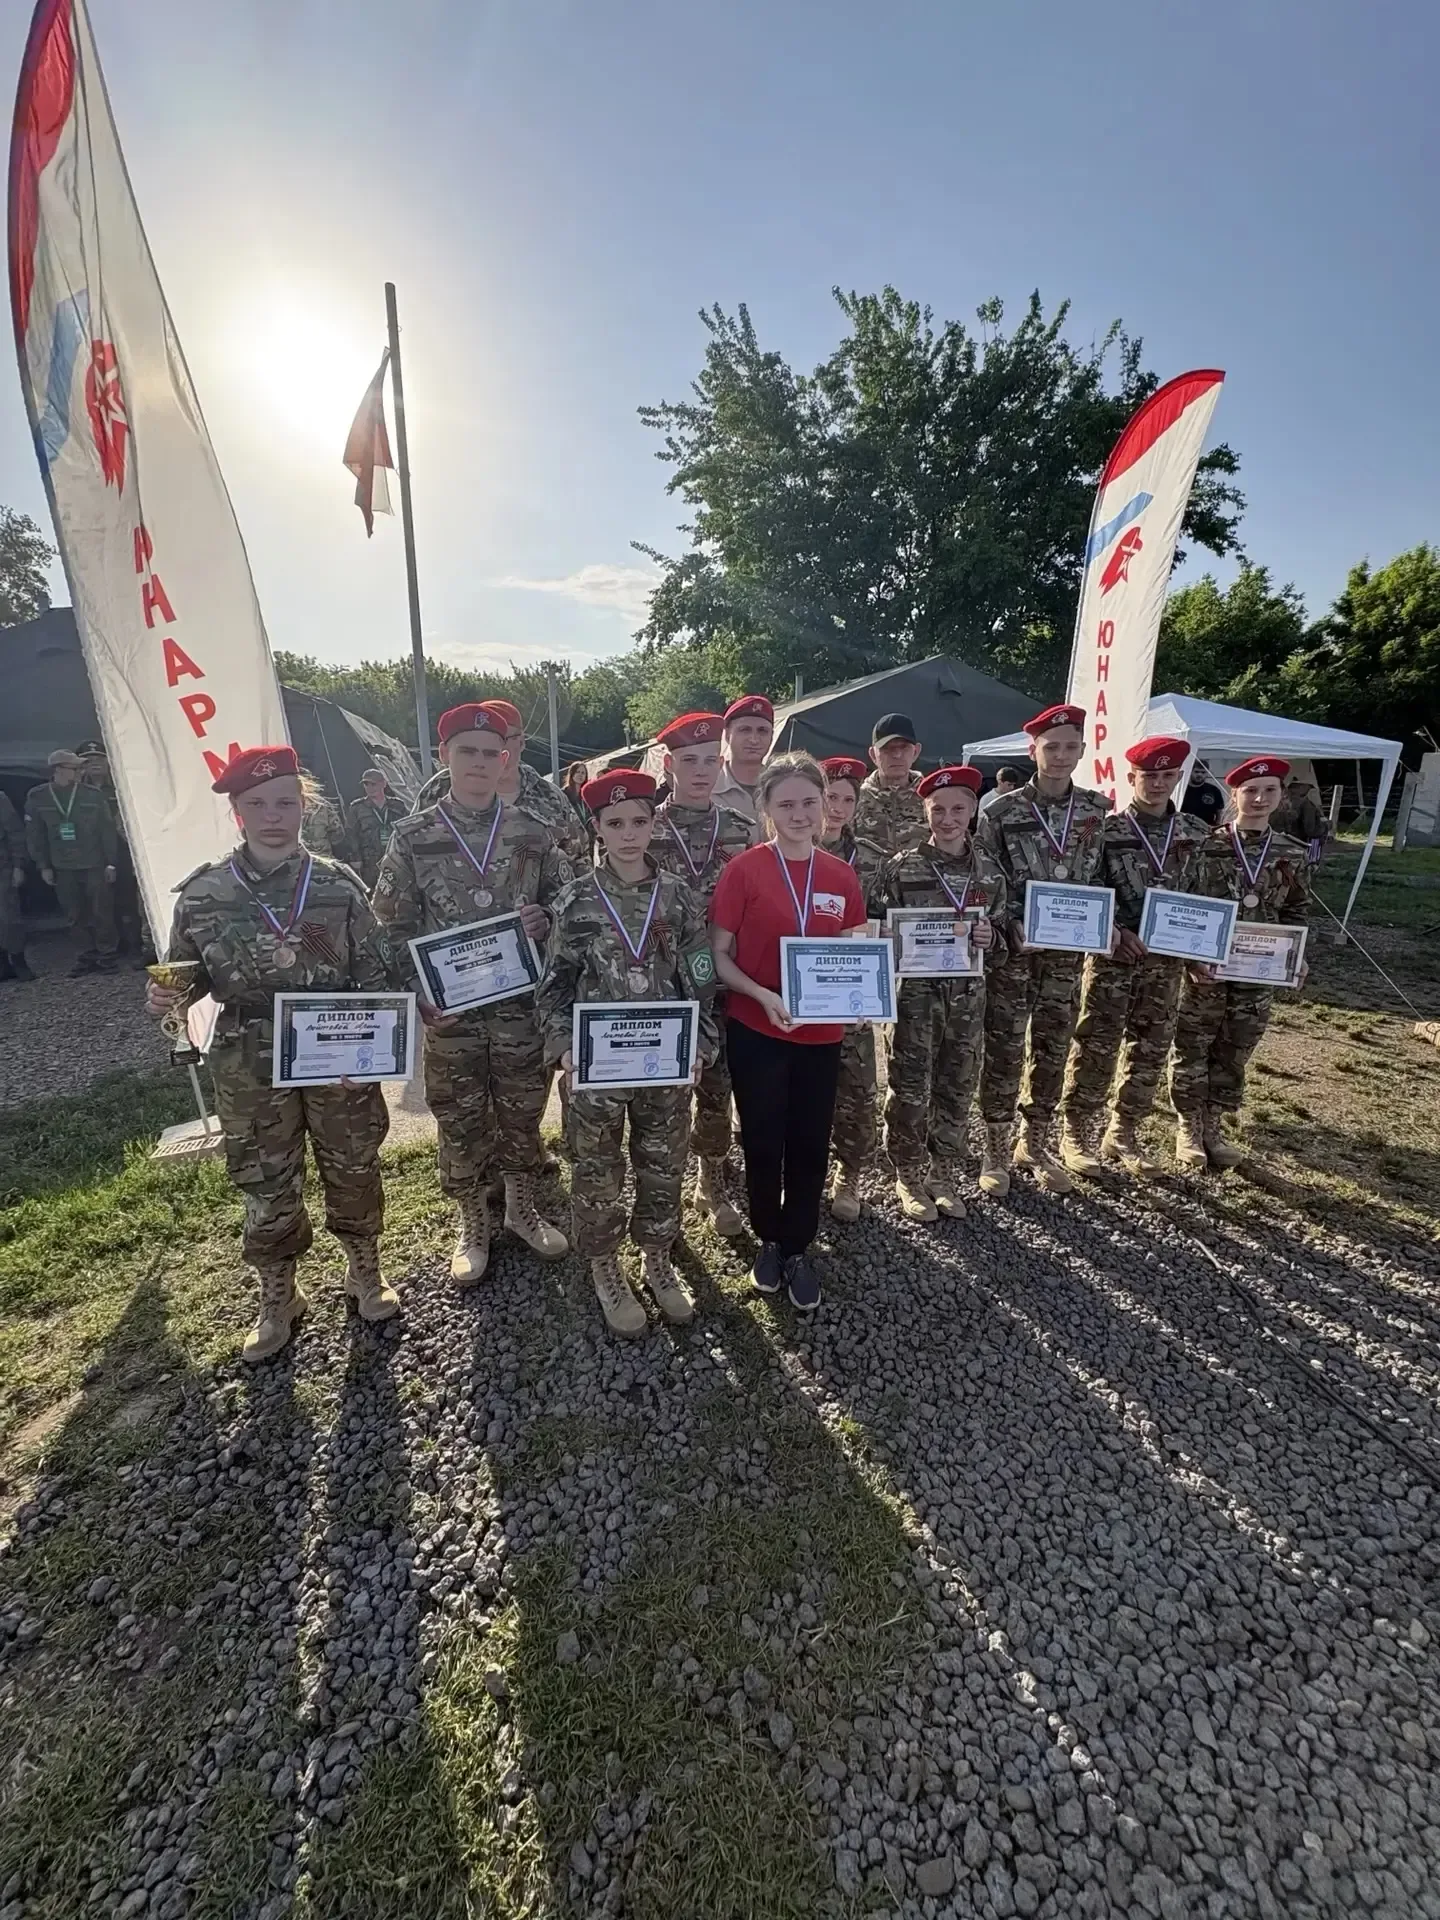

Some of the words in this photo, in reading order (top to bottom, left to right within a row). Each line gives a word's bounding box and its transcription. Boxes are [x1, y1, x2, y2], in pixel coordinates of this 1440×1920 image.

[1052, 898, 1088, 907] ДИПЛОМ
[1170, 905, 1209, 917] ДИПЛОМ
[915, 922, 954, 931] ДИПЛОМ
[1237, 935, 1277, 944] ДИПЛОМ
[449, 936, 498, 957] ДИПЛОМ
[815, 957, 862, 966] ДИПЛОМ
[317, 1012, 375, 1023] ДИПЛОМ
[611, 1021, 662, 1031] ДИПЛОМ
